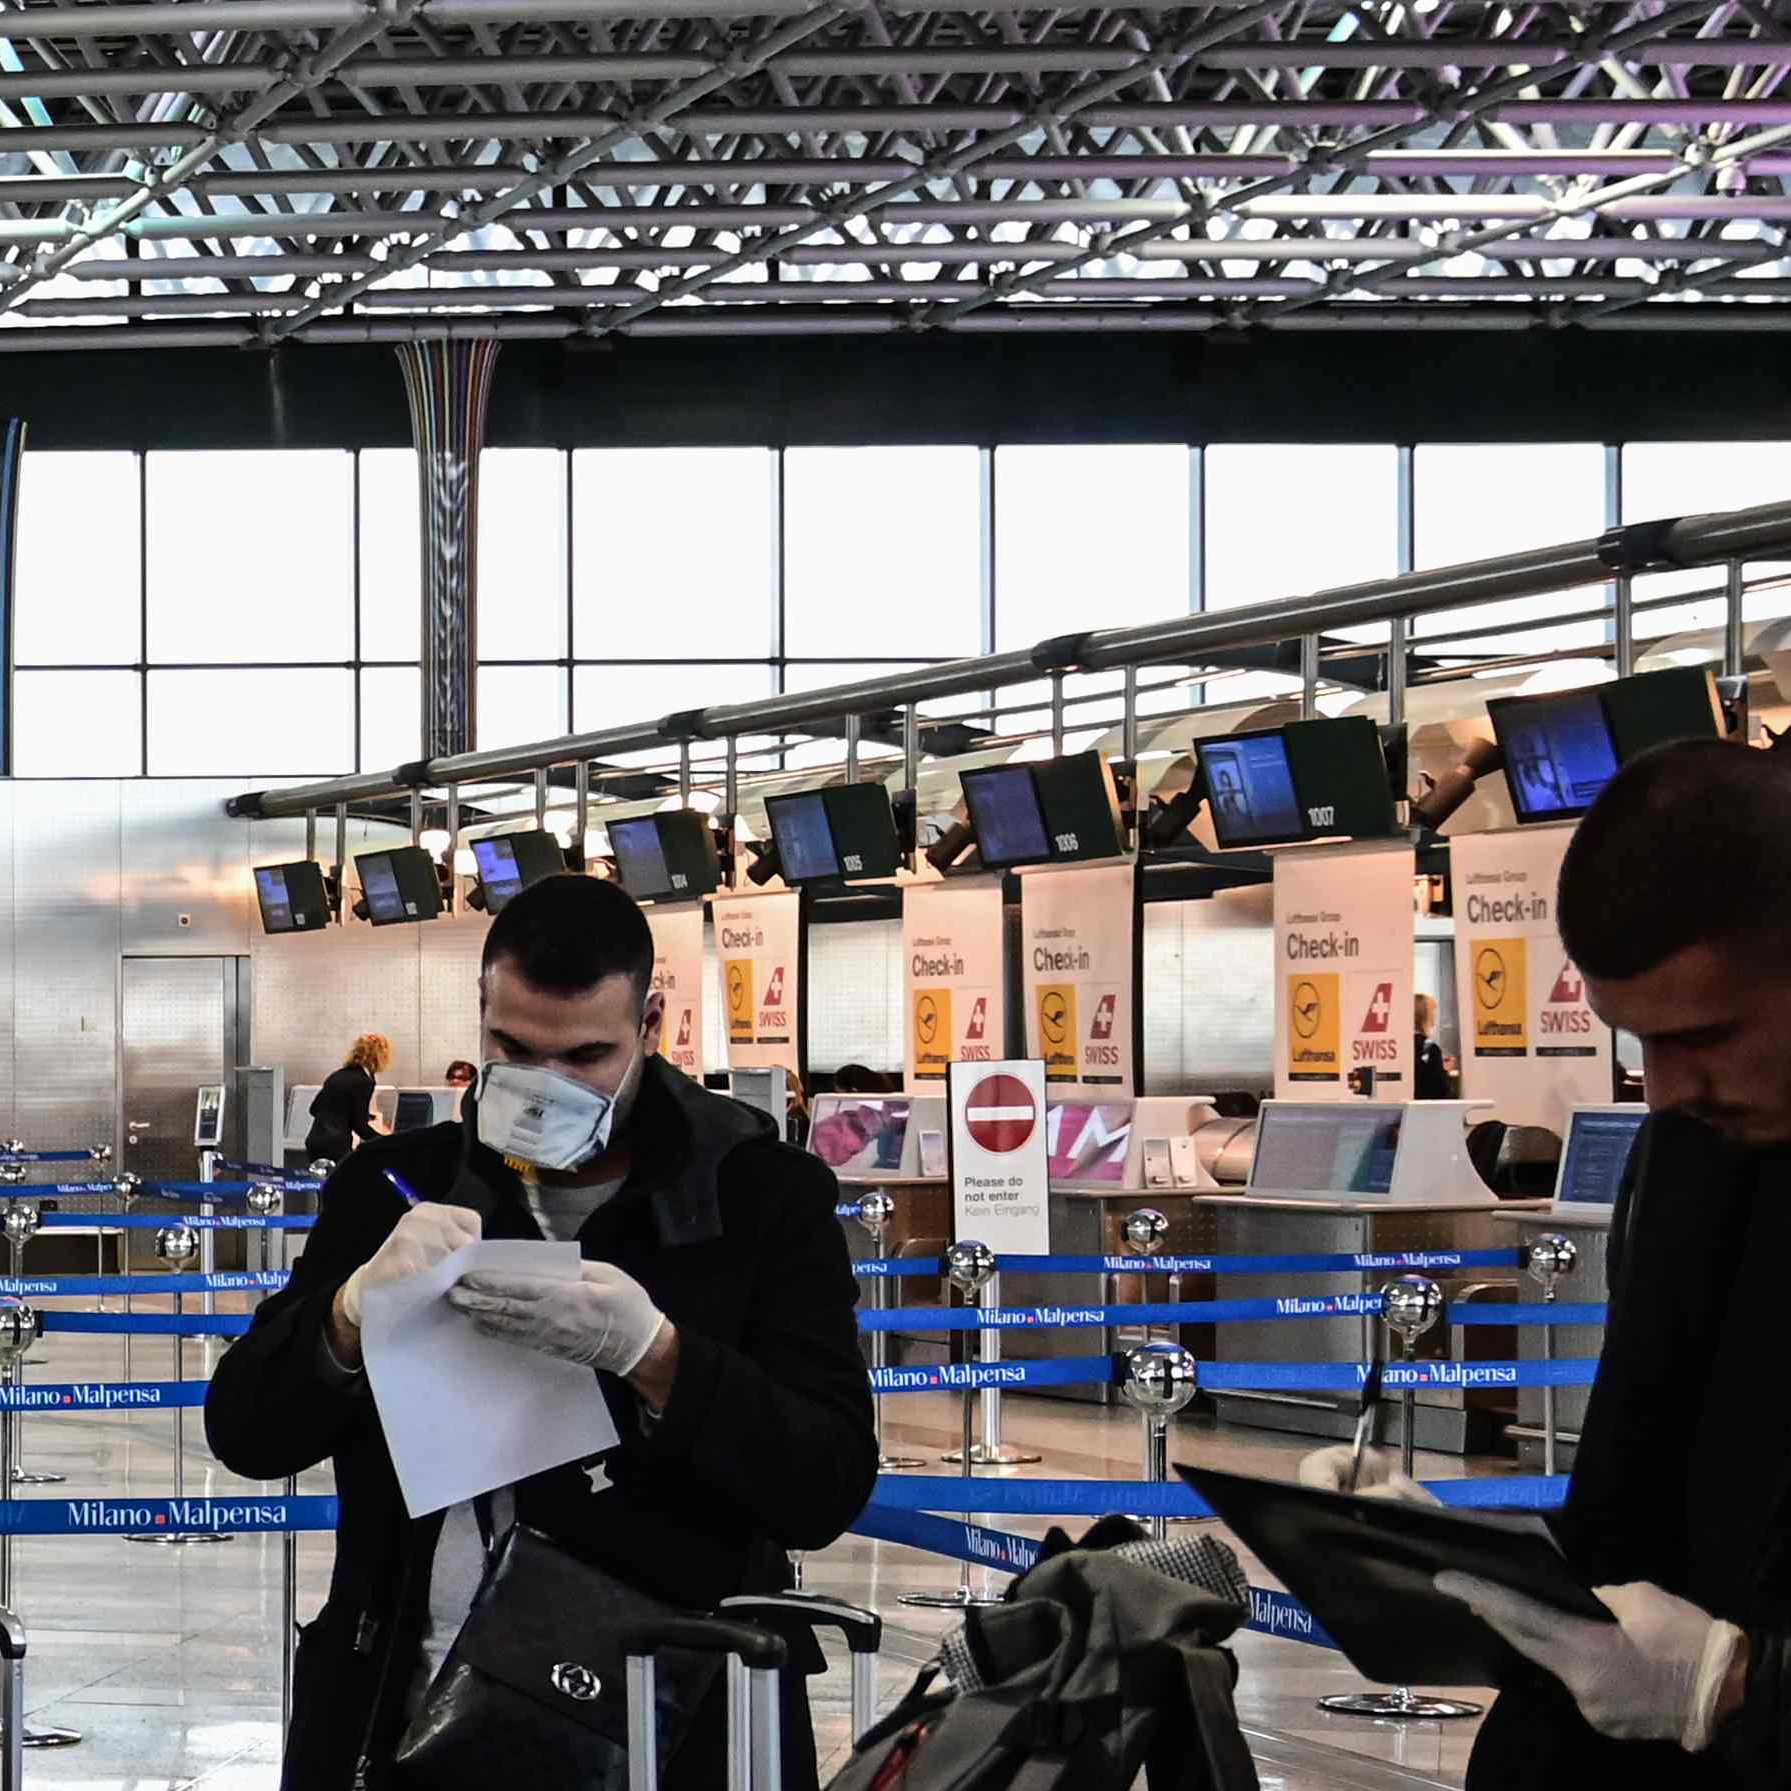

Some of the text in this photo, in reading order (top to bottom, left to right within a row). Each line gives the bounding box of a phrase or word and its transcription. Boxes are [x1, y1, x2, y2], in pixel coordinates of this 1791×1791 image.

[1307, 806, 1335, 827] 1007
[1467, 893, 1548, 924] Check-in
[722, 927, 764, 949] Check-in
[1287, 932, 1360, 961] Check-in
[912, 952, 965, 977] Check-in
[1033, 947, 1090, 971] Check-in
[758, 1011, 787, 1028] SWISS
[1477, 1020, 1523, 1036] Lufthansa
[1540, 1009, 1592, 1035] SWISS
[960, 1045, 991, 1062] SWISS
[1084, 1046, 1119, 1065] SWISS
[1293, 1047, 1337, 1064] Lufthansa
[1352, 1039, 1398, 1062] SWISS
[964, 1176, 1023, 1188] Please do
[964, 1191, 1020, 1202] not enter
[964, 1202, 1042, 1218] Kein Eingang
[183, 1215, 267, 1229] Milano Malpensa
[852, 1262, 888, 1275] pensa
[1103, 1256, 1212, 1273] Milano Malpensa
[1354, 1252, 1462, 1269] Milano Malpensa
[206, 1275, 249, 1288] Milano
[1276, 1297, 1326, 1314] Milano
[976, 1306, 1105, 1326] Milano Malpensa
[867, 1363, 1026, 1388] Milano Malpensa
[1428, 1361, 1517, 1387] Malpensa
[71, 1384, 161, 1409] Malpensa
[67, 1499, 287, 1531] Milano Malpensa
[965, 1525, 1001, 1560] Milano
